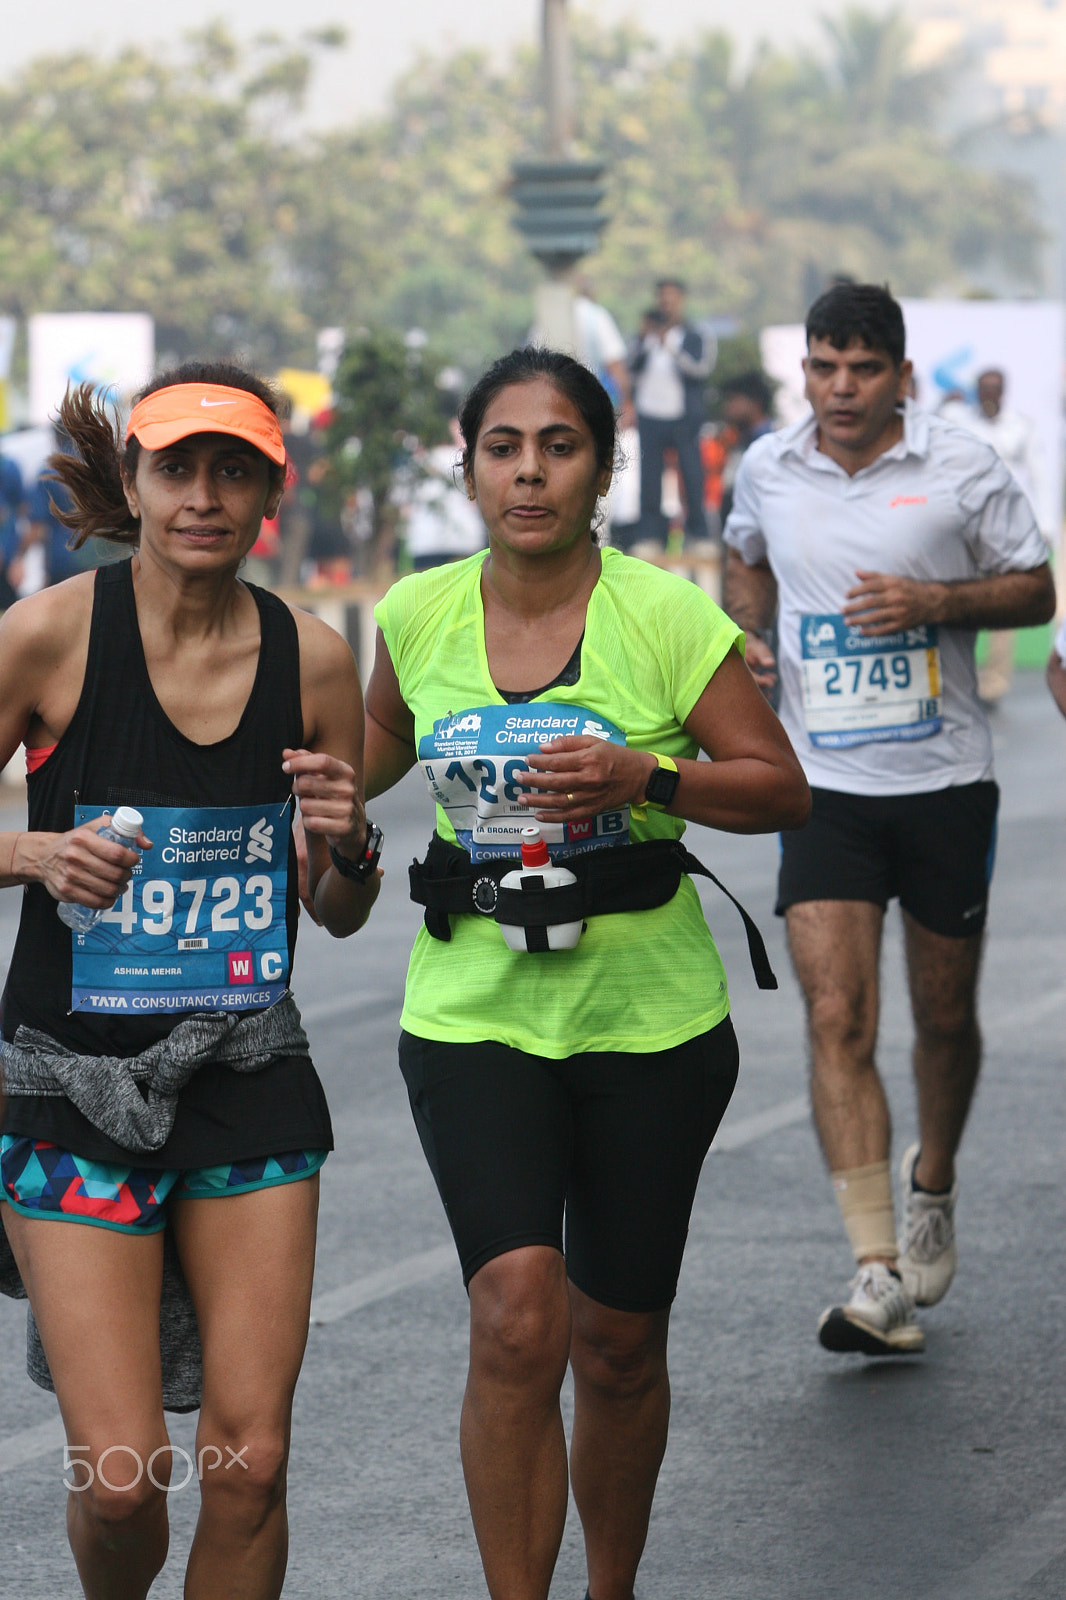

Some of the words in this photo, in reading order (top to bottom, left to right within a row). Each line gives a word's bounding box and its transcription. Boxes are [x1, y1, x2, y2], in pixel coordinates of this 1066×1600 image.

[824, 655, 911, 696] 2749
[504, 716, 579, 730] Standard
[445, 759, 547, 804] 128
[571, 822, 589, 835] W
[602, 813, 624, 833] B
[169, 826, 243, 844] Standard
[161, 845, 241, 864] Chartered
[101, 874, 273, 936] 49723
[113, 967, 149, 976] ASHIMA
[151, 967, 183, 976] MEHRA
[232, 960, 249, 976] W
[260, 952, 283, 981] C
[89, 995, 128, 1008] TATA
[131, 993, 219, 1009] CONSULTANCY
[221, 991, 270, 1006] SERVICES
